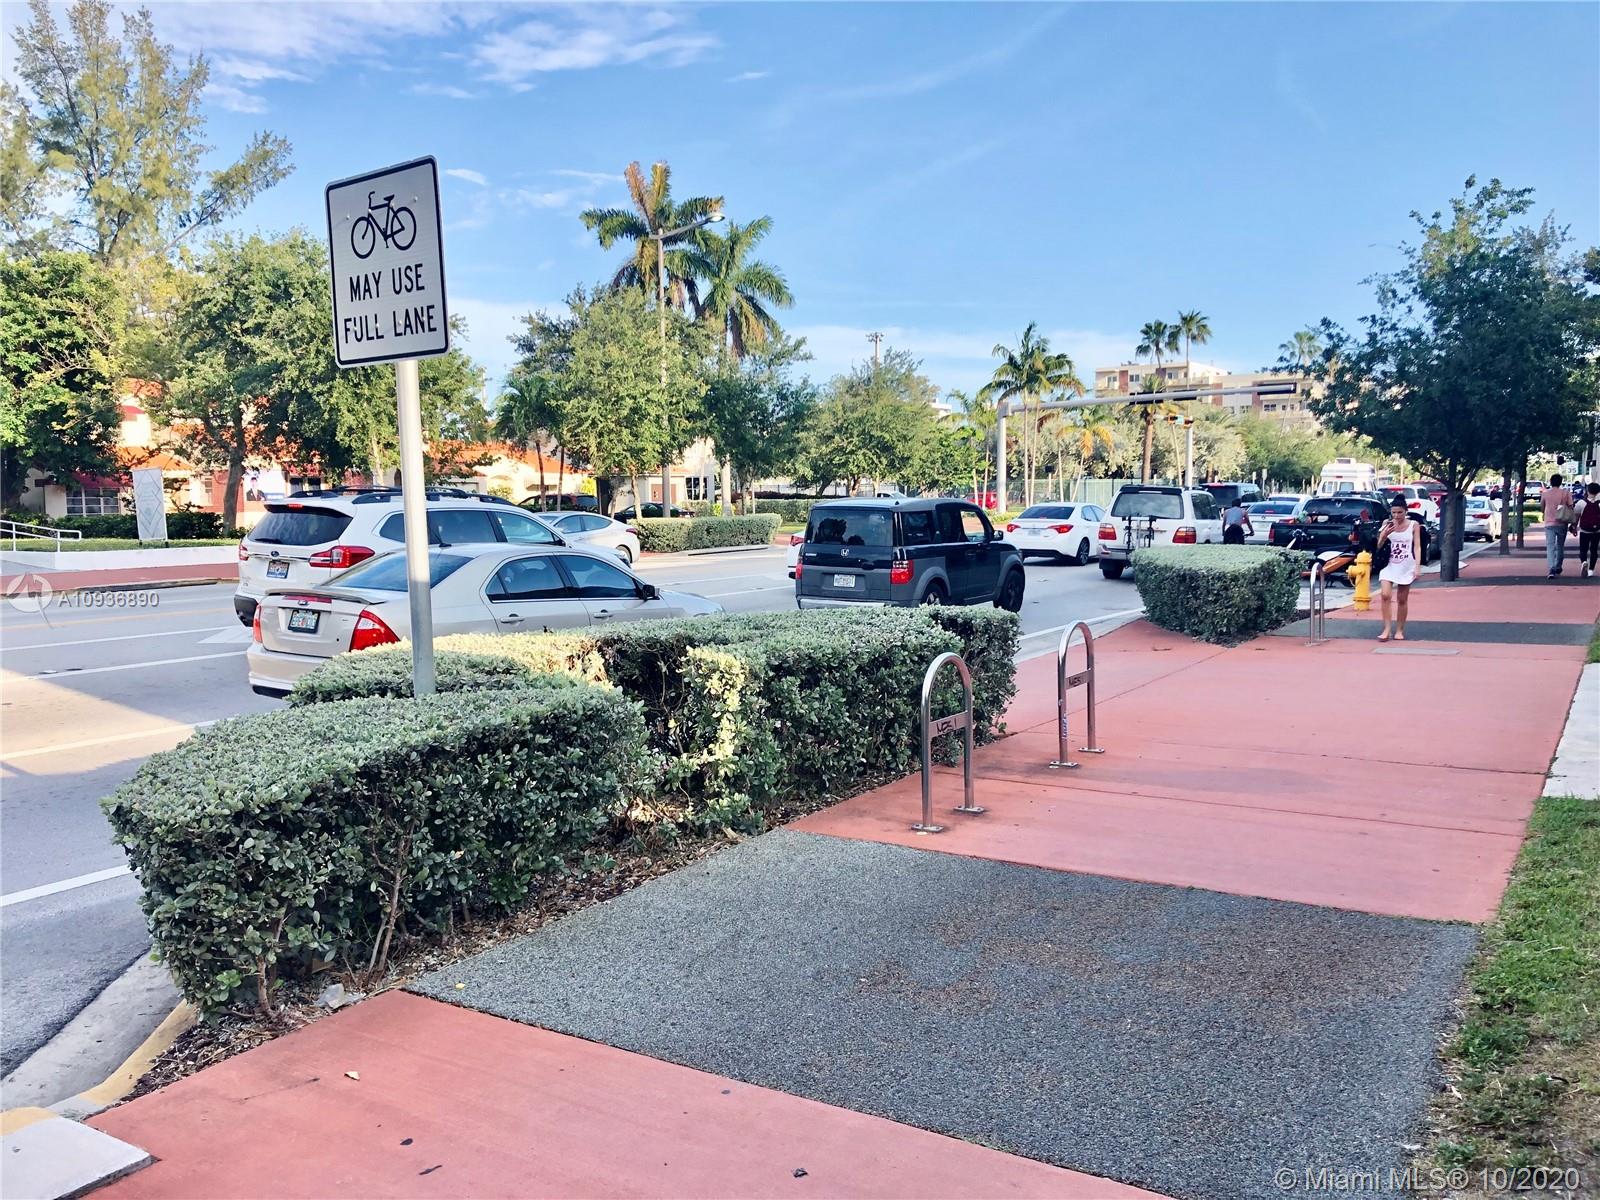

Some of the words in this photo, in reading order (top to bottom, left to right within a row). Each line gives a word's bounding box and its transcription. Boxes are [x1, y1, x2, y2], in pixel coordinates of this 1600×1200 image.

[350, 271, 382, 302] MAY
[392, 263, 425, 295] USE
[344, 314, 384, 344] FULL
[393, 304, 437, 337] LANE
